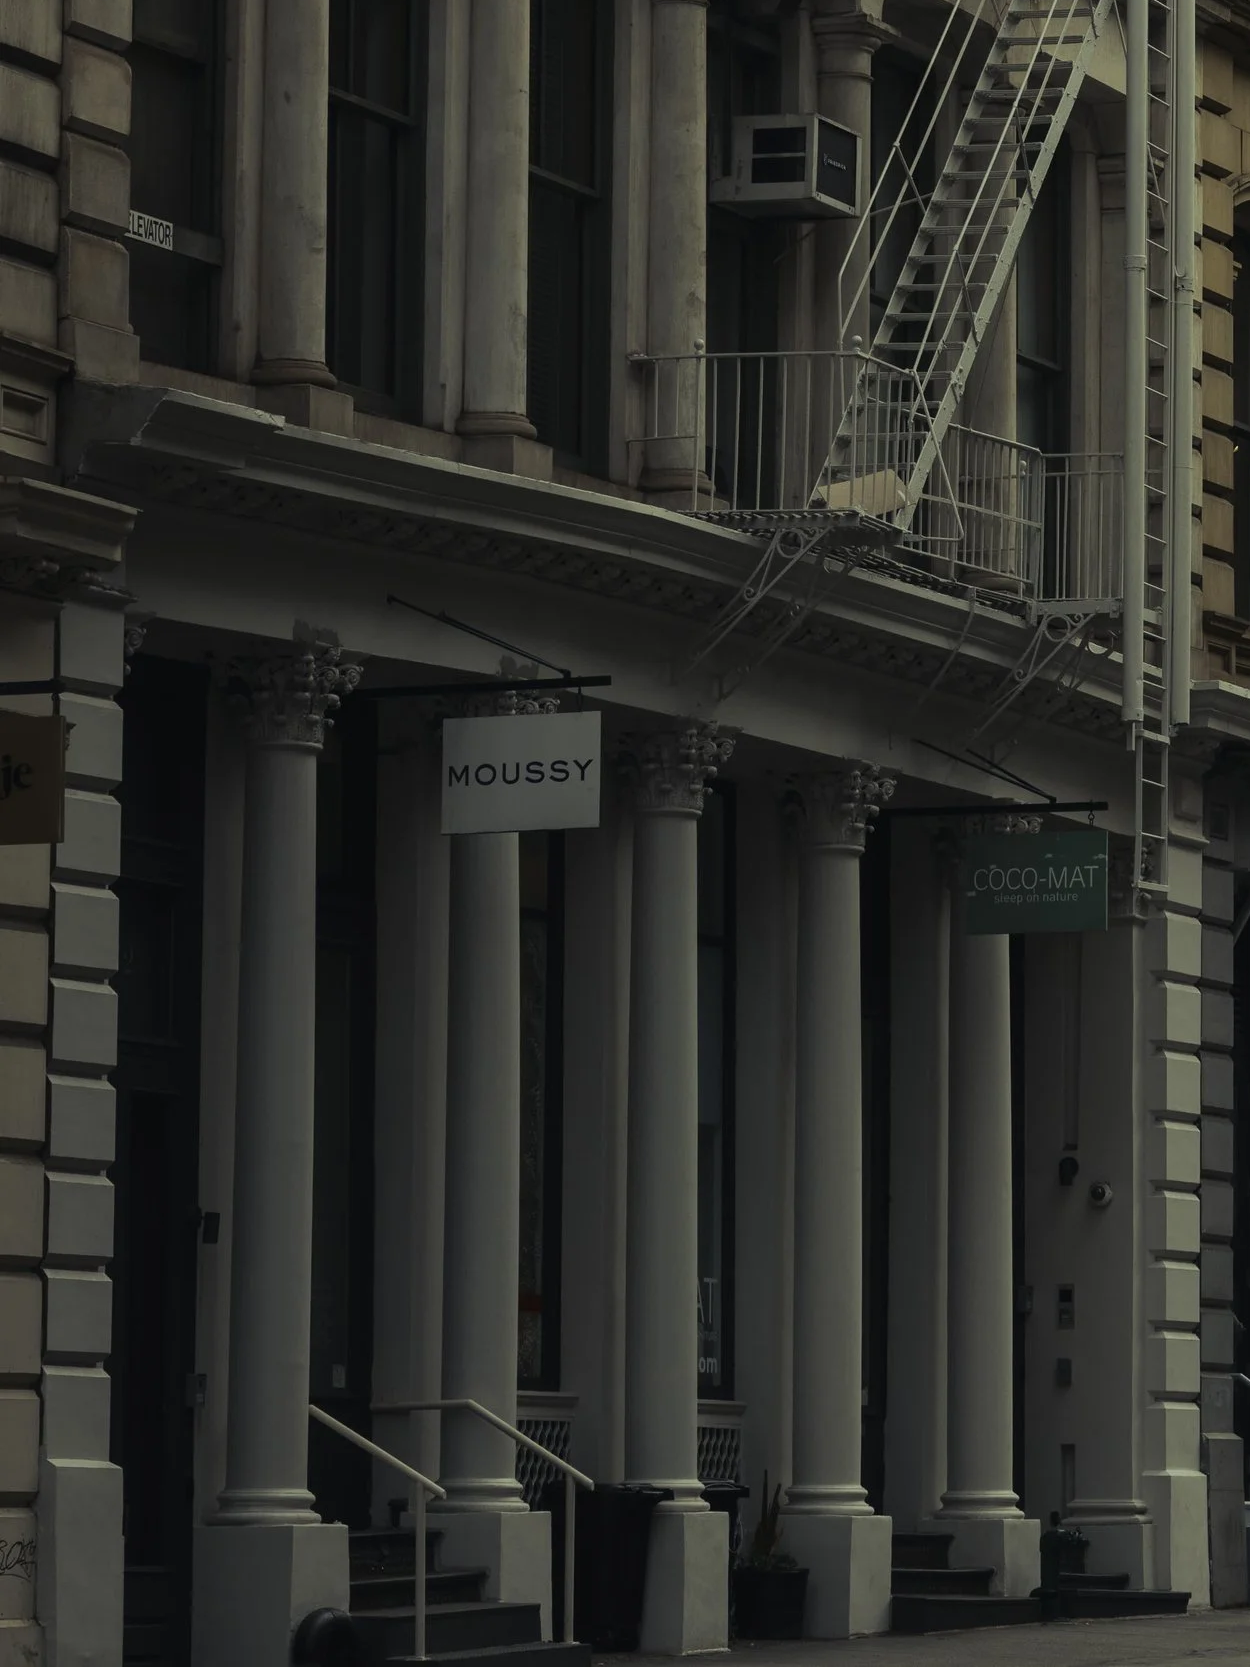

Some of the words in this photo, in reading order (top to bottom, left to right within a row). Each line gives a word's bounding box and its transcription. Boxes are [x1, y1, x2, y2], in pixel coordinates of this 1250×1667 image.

[129, 212, 171, 247] LEVATOR
[448, 759, 594, 787] MOUSSY
[974, 865, 1100, 891] COCO-MAT
[994, 892, 1024, 906] sleep
[1026, 894, 1040, 904] on
[1042, 891, 1079, 903] nature
